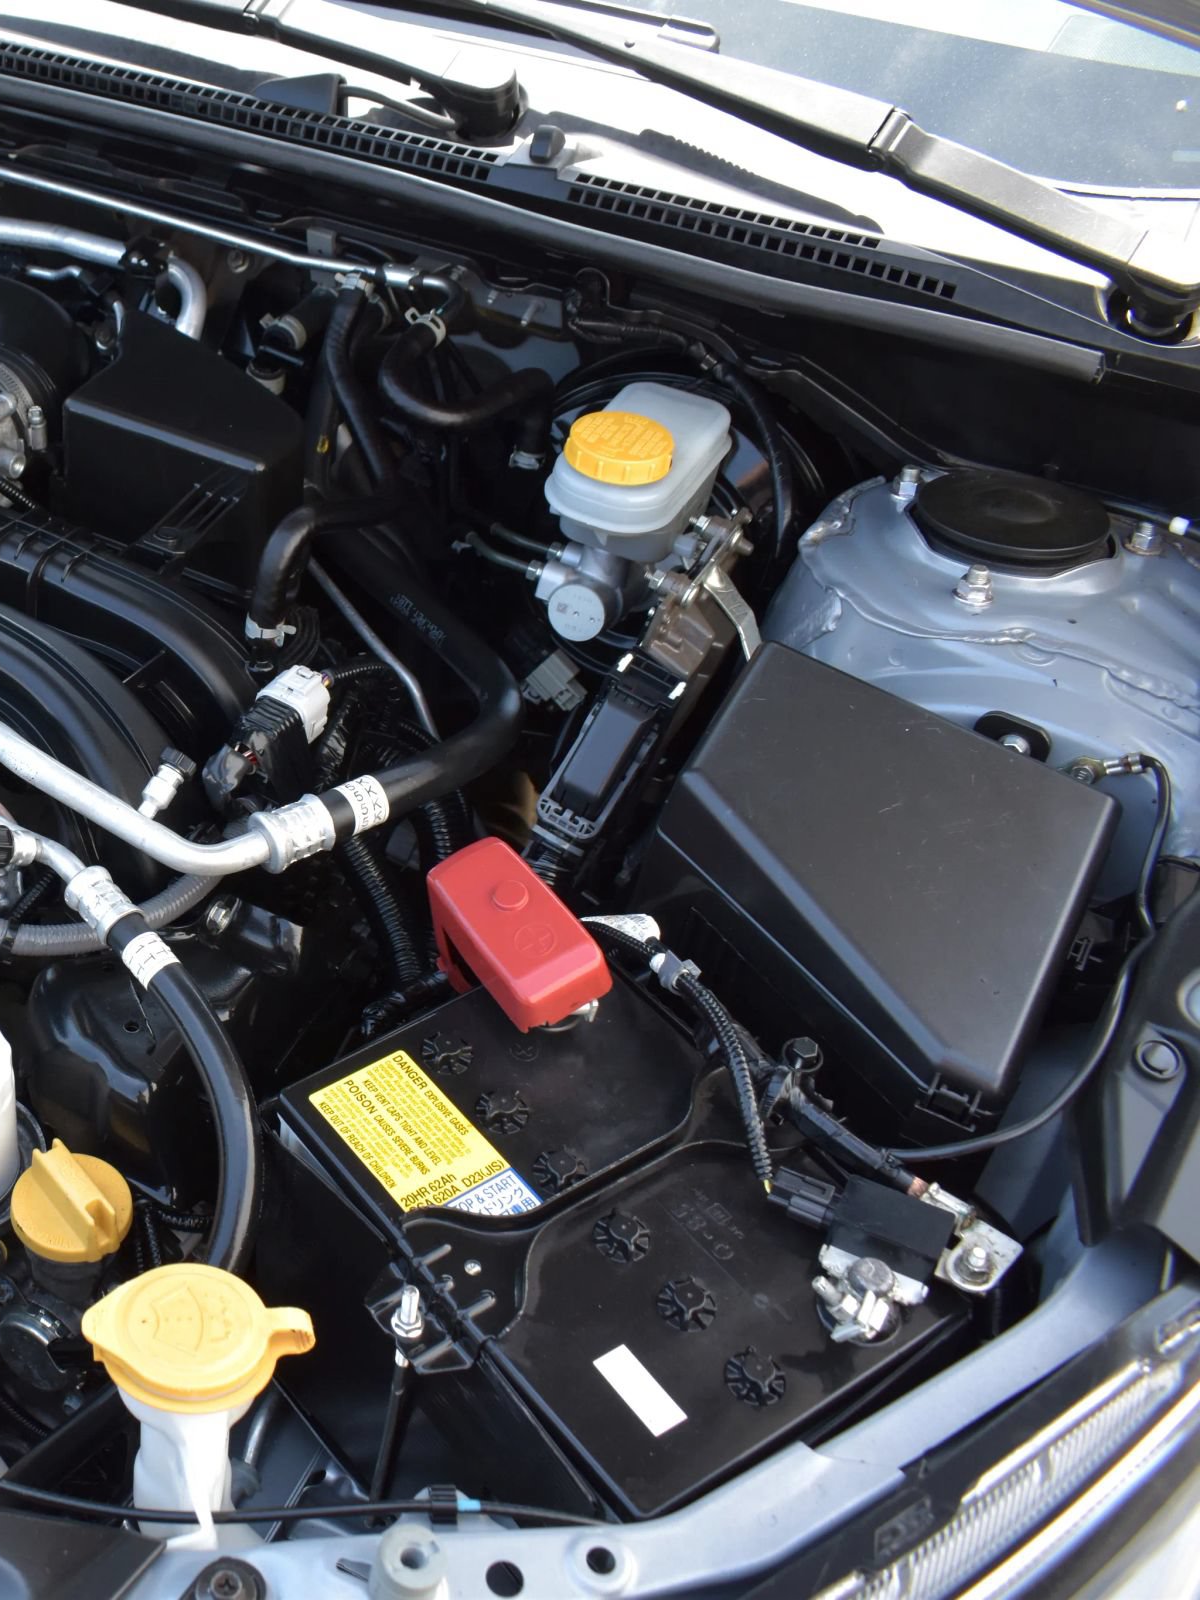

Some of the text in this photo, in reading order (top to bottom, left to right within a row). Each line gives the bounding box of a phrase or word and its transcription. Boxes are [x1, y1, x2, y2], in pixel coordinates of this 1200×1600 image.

[344, 1080, 430, 1176] POISON CAUSES SEVERE BURNS
[362, 1078, 442, 1167] KEEP VENT CAPS TIGHT AND LEVEL
[392, 1055, 469, 1136] DANGER EXPLOSIVE GASES
[319, 1102, 332, 1116] KEEP
[330, 1113, 342, 1126] OUT
[347, 1132, 365, 1153] REACH
[369, 1159, 397, 1189] CHILDREN
[435, 1186, 461, 1204] 620A
[462, 1159, 505, 1188] D23(JIS)
[401, 1173, 457, 1208] 20HR 62Ah
[473, 1192, 485, 1205] &
[483, 1175, 517, 1201] START
